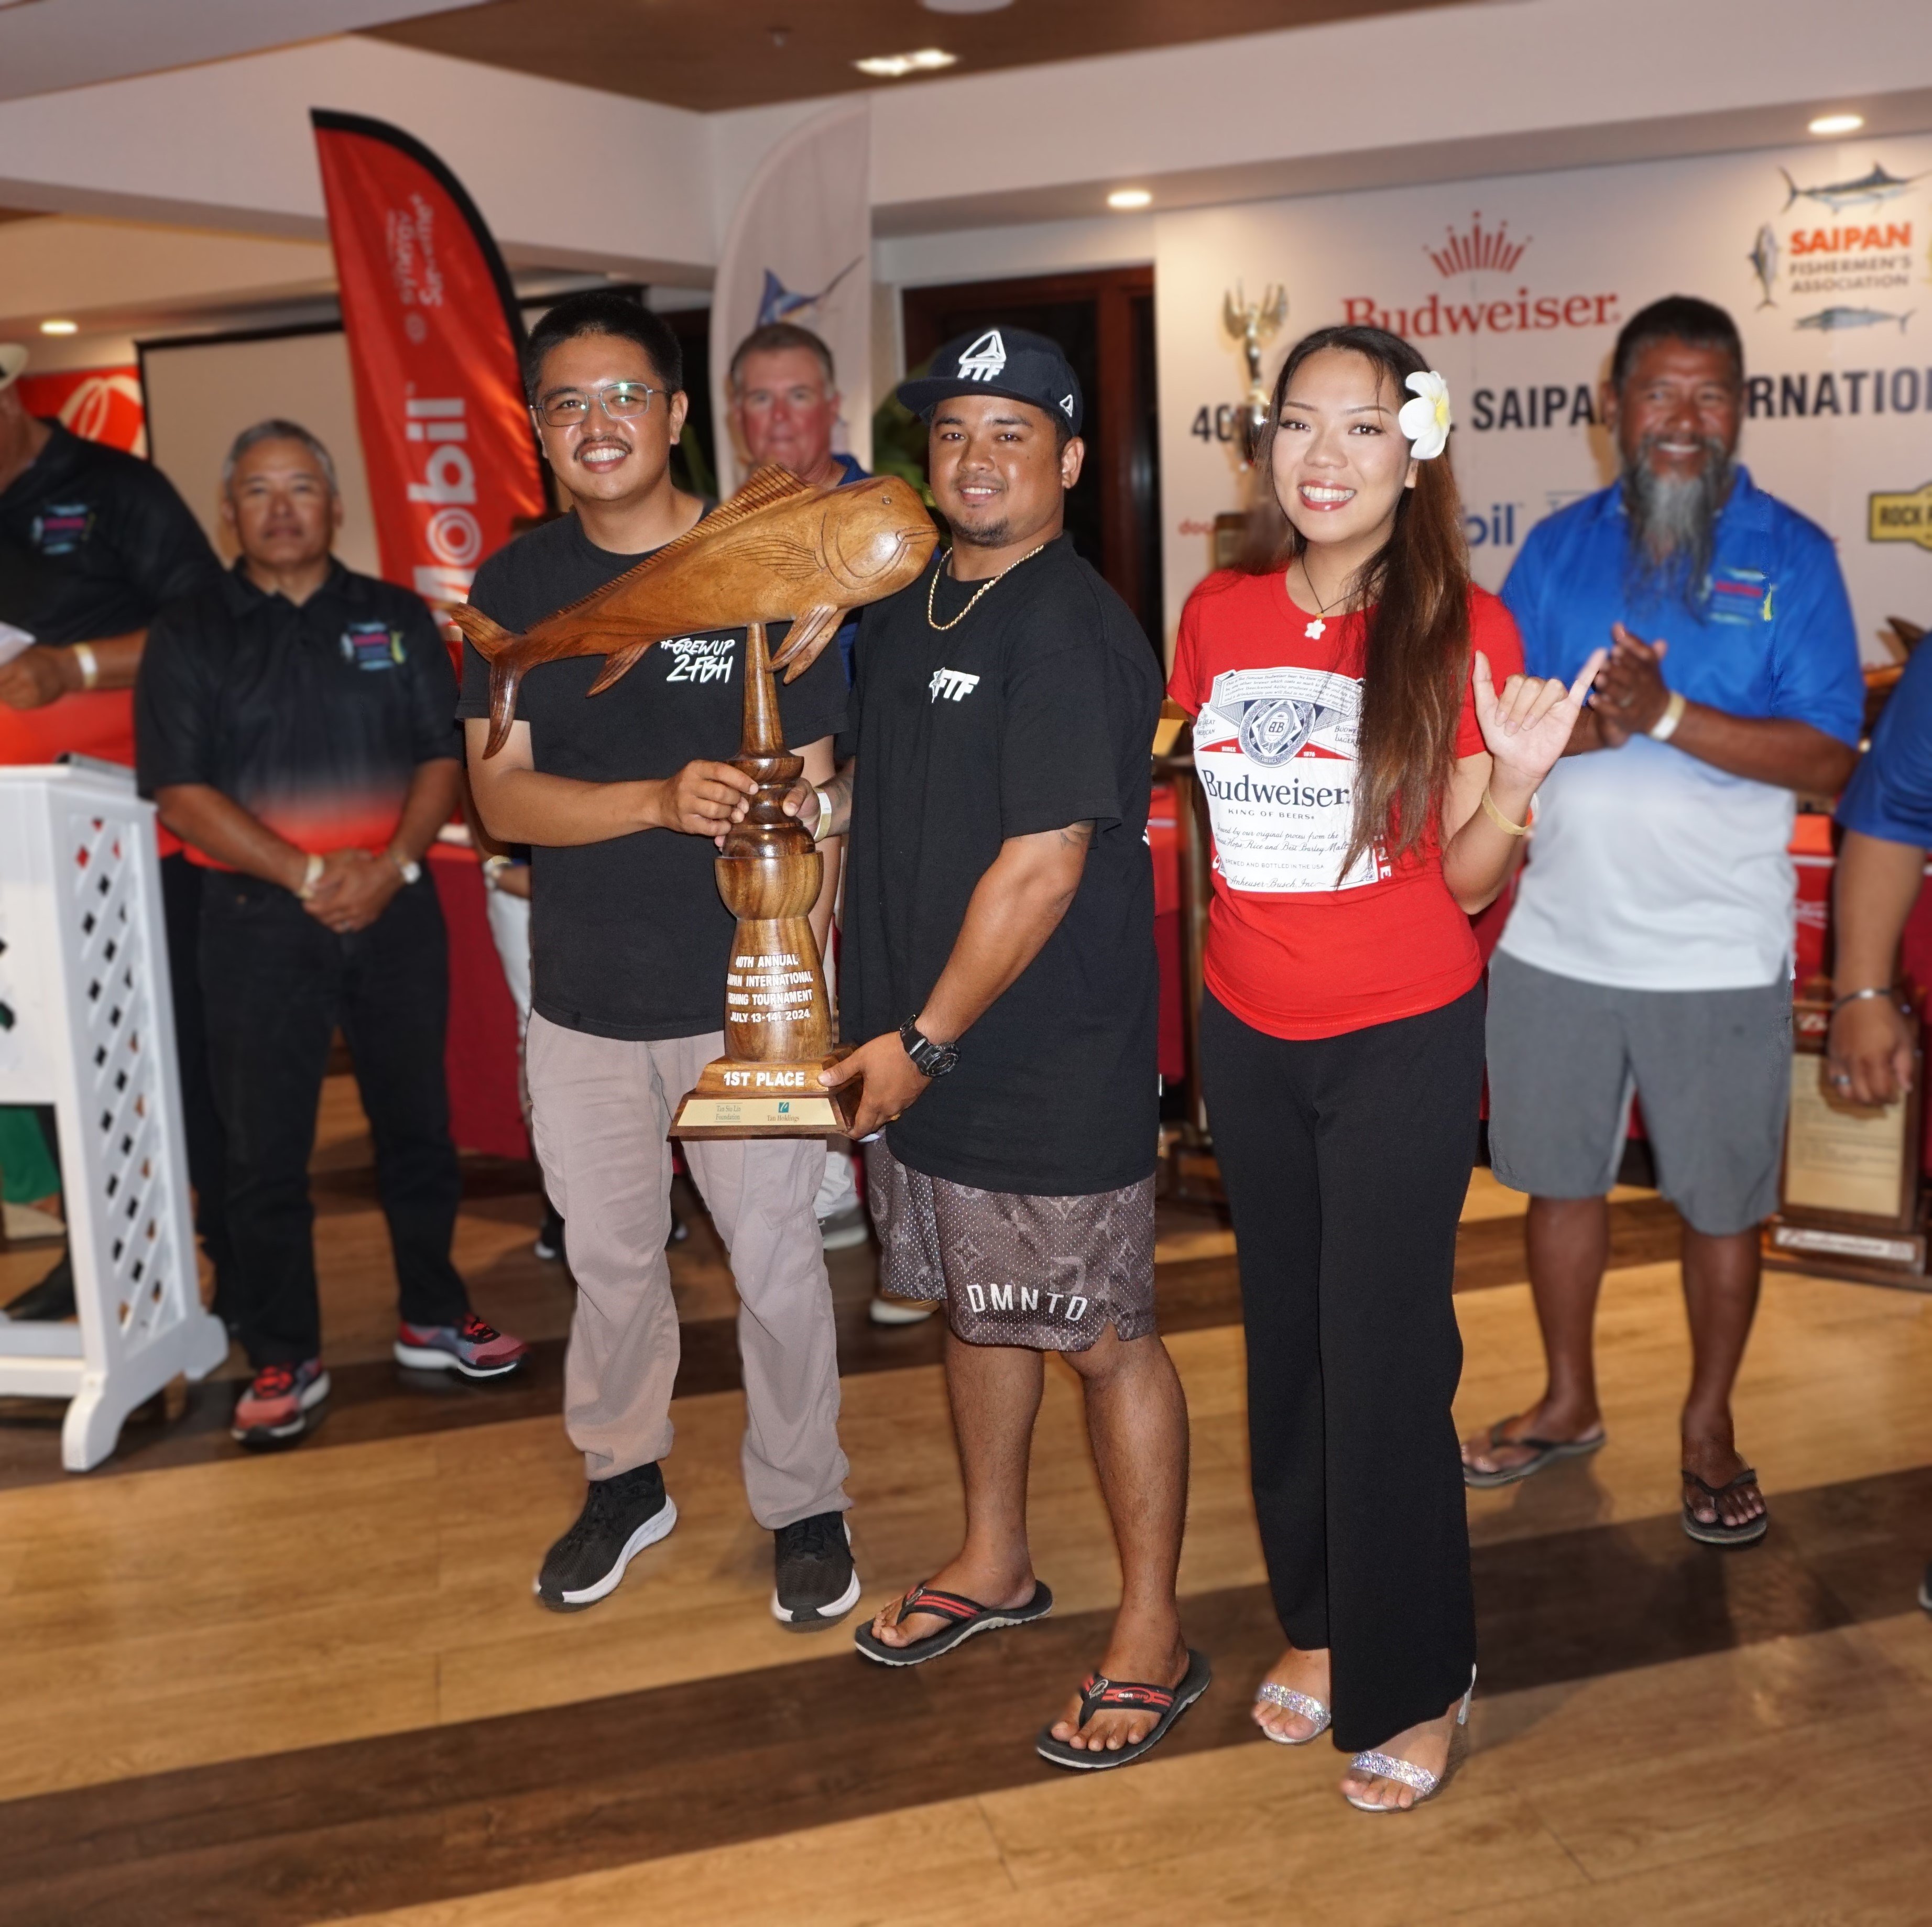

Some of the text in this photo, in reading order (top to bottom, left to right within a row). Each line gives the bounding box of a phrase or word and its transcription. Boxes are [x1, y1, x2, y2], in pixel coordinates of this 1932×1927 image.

[1790, 223, 1912, 256] SAIPAN
[1790, 254, 1911, 276] FISHERMEN'S
[1792, 273, 1908, 293] ASSOCIATION
[1342, 286, 1619, 340] Budweiser
[1472, 385, 1597, 432] SAIPA
[1202, 769, 1349, 807] Budweiser
[1232, 827, 1241, 839] by
[1256, 830, 1283, 842] original
[1307, 831, 1325, 842] from
[1327, 831, 1339, 839] the
[1242, 839, 1263, 849] Rice
[1282, 841, 1299, 851] Best
[1299, 842, 1324, 856] Barley
[1225, 858, 1245, 867] BREWED
[735, 954, 799, 968] 40TH ANNUAL
[746, 970, 813, 987] INTERNATIONAL
[728, 989, 812, 1005] FISHING TOURNAMENT
[730, 1011, 748, 1023] JULY
[785, 1008, 811, 1021] 2024
[724, 1071, 805, 1087] 1ST PLACE
[966, 1283, 1088, 1322] DMNTD
